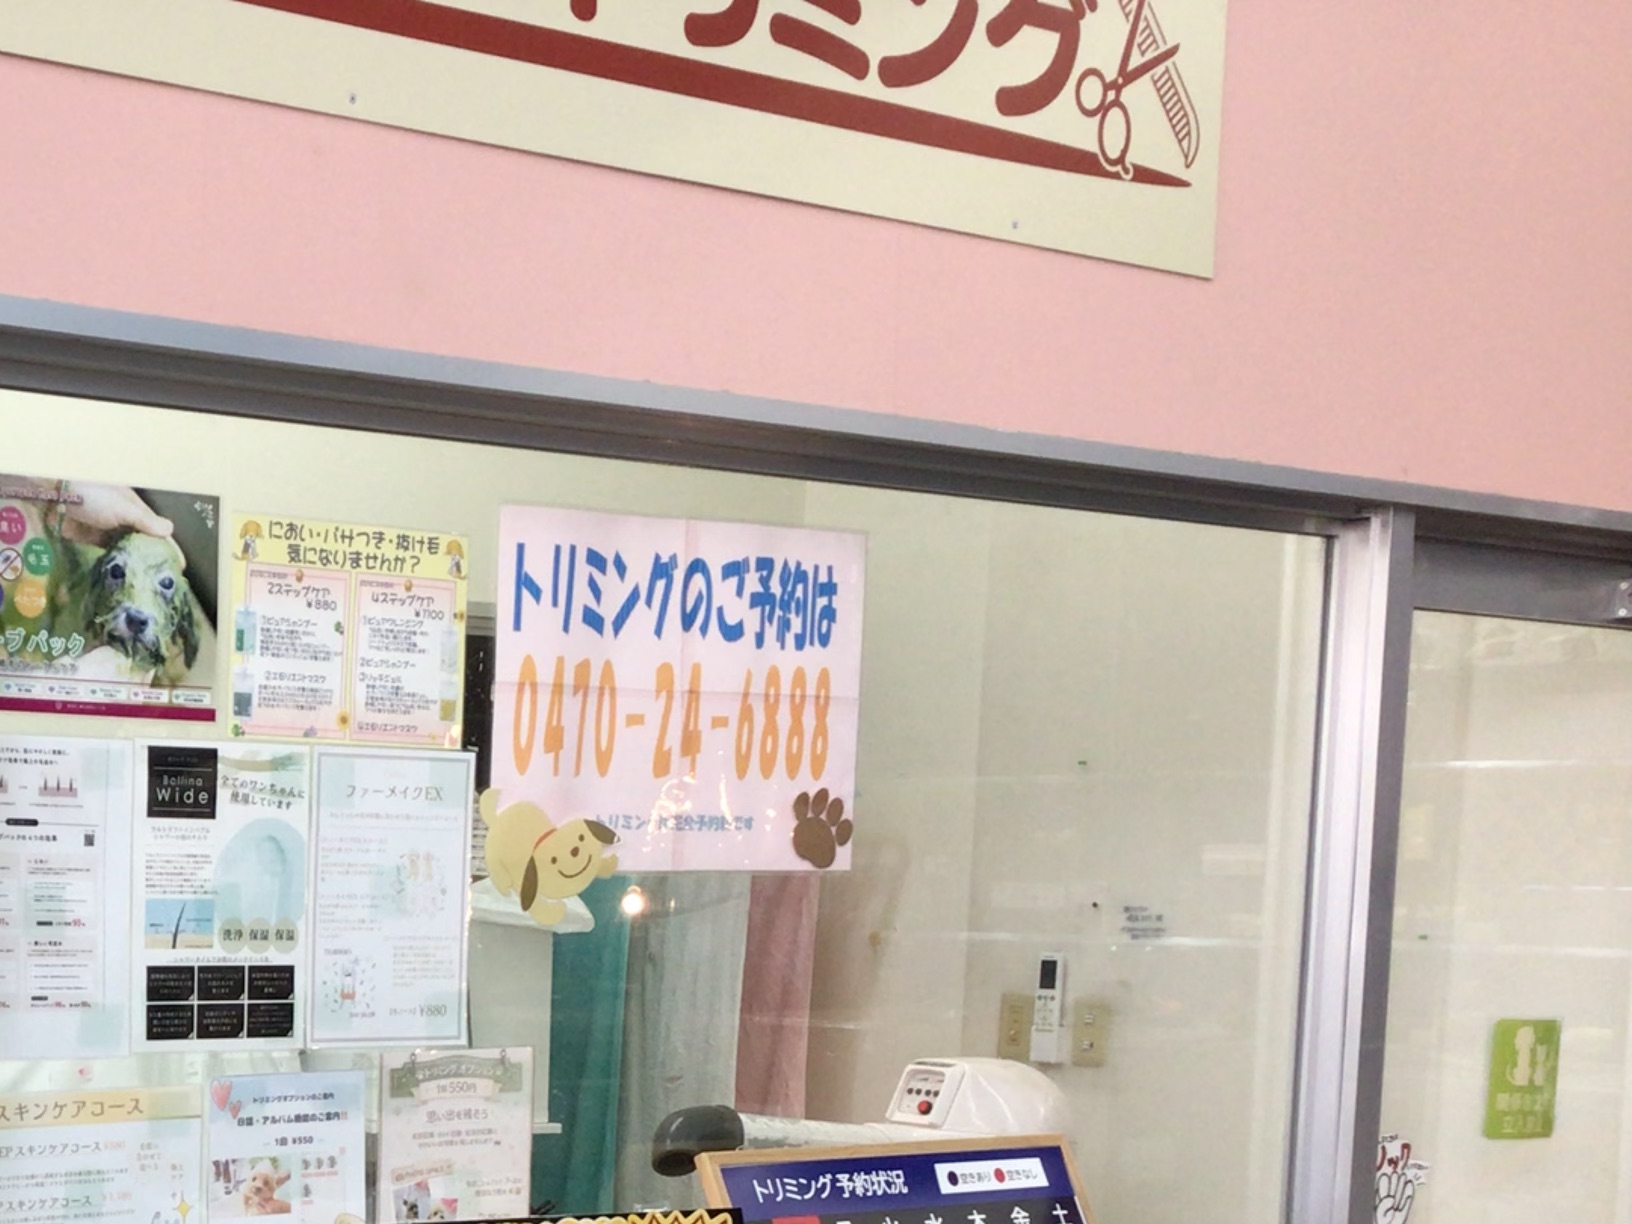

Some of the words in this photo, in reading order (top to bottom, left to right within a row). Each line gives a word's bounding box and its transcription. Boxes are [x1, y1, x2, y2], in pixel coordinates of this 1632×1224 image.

[268, 519, 440, 556] におい・パサつき・抜け毛
[286, 543, 421, 574] 気になりませんか？
[512, 541, 839, 652] トリミングのご予約は
[512, 653, 832, 783] 0470-24-6888
[156, 786, 209, 805] Wide
[220, 774, 306, 799] 全てのワンちゃんに
[15, 1141, 102, 1158] スキンケアコース
[5, 1195, 93, 1211] スキンケアコース
